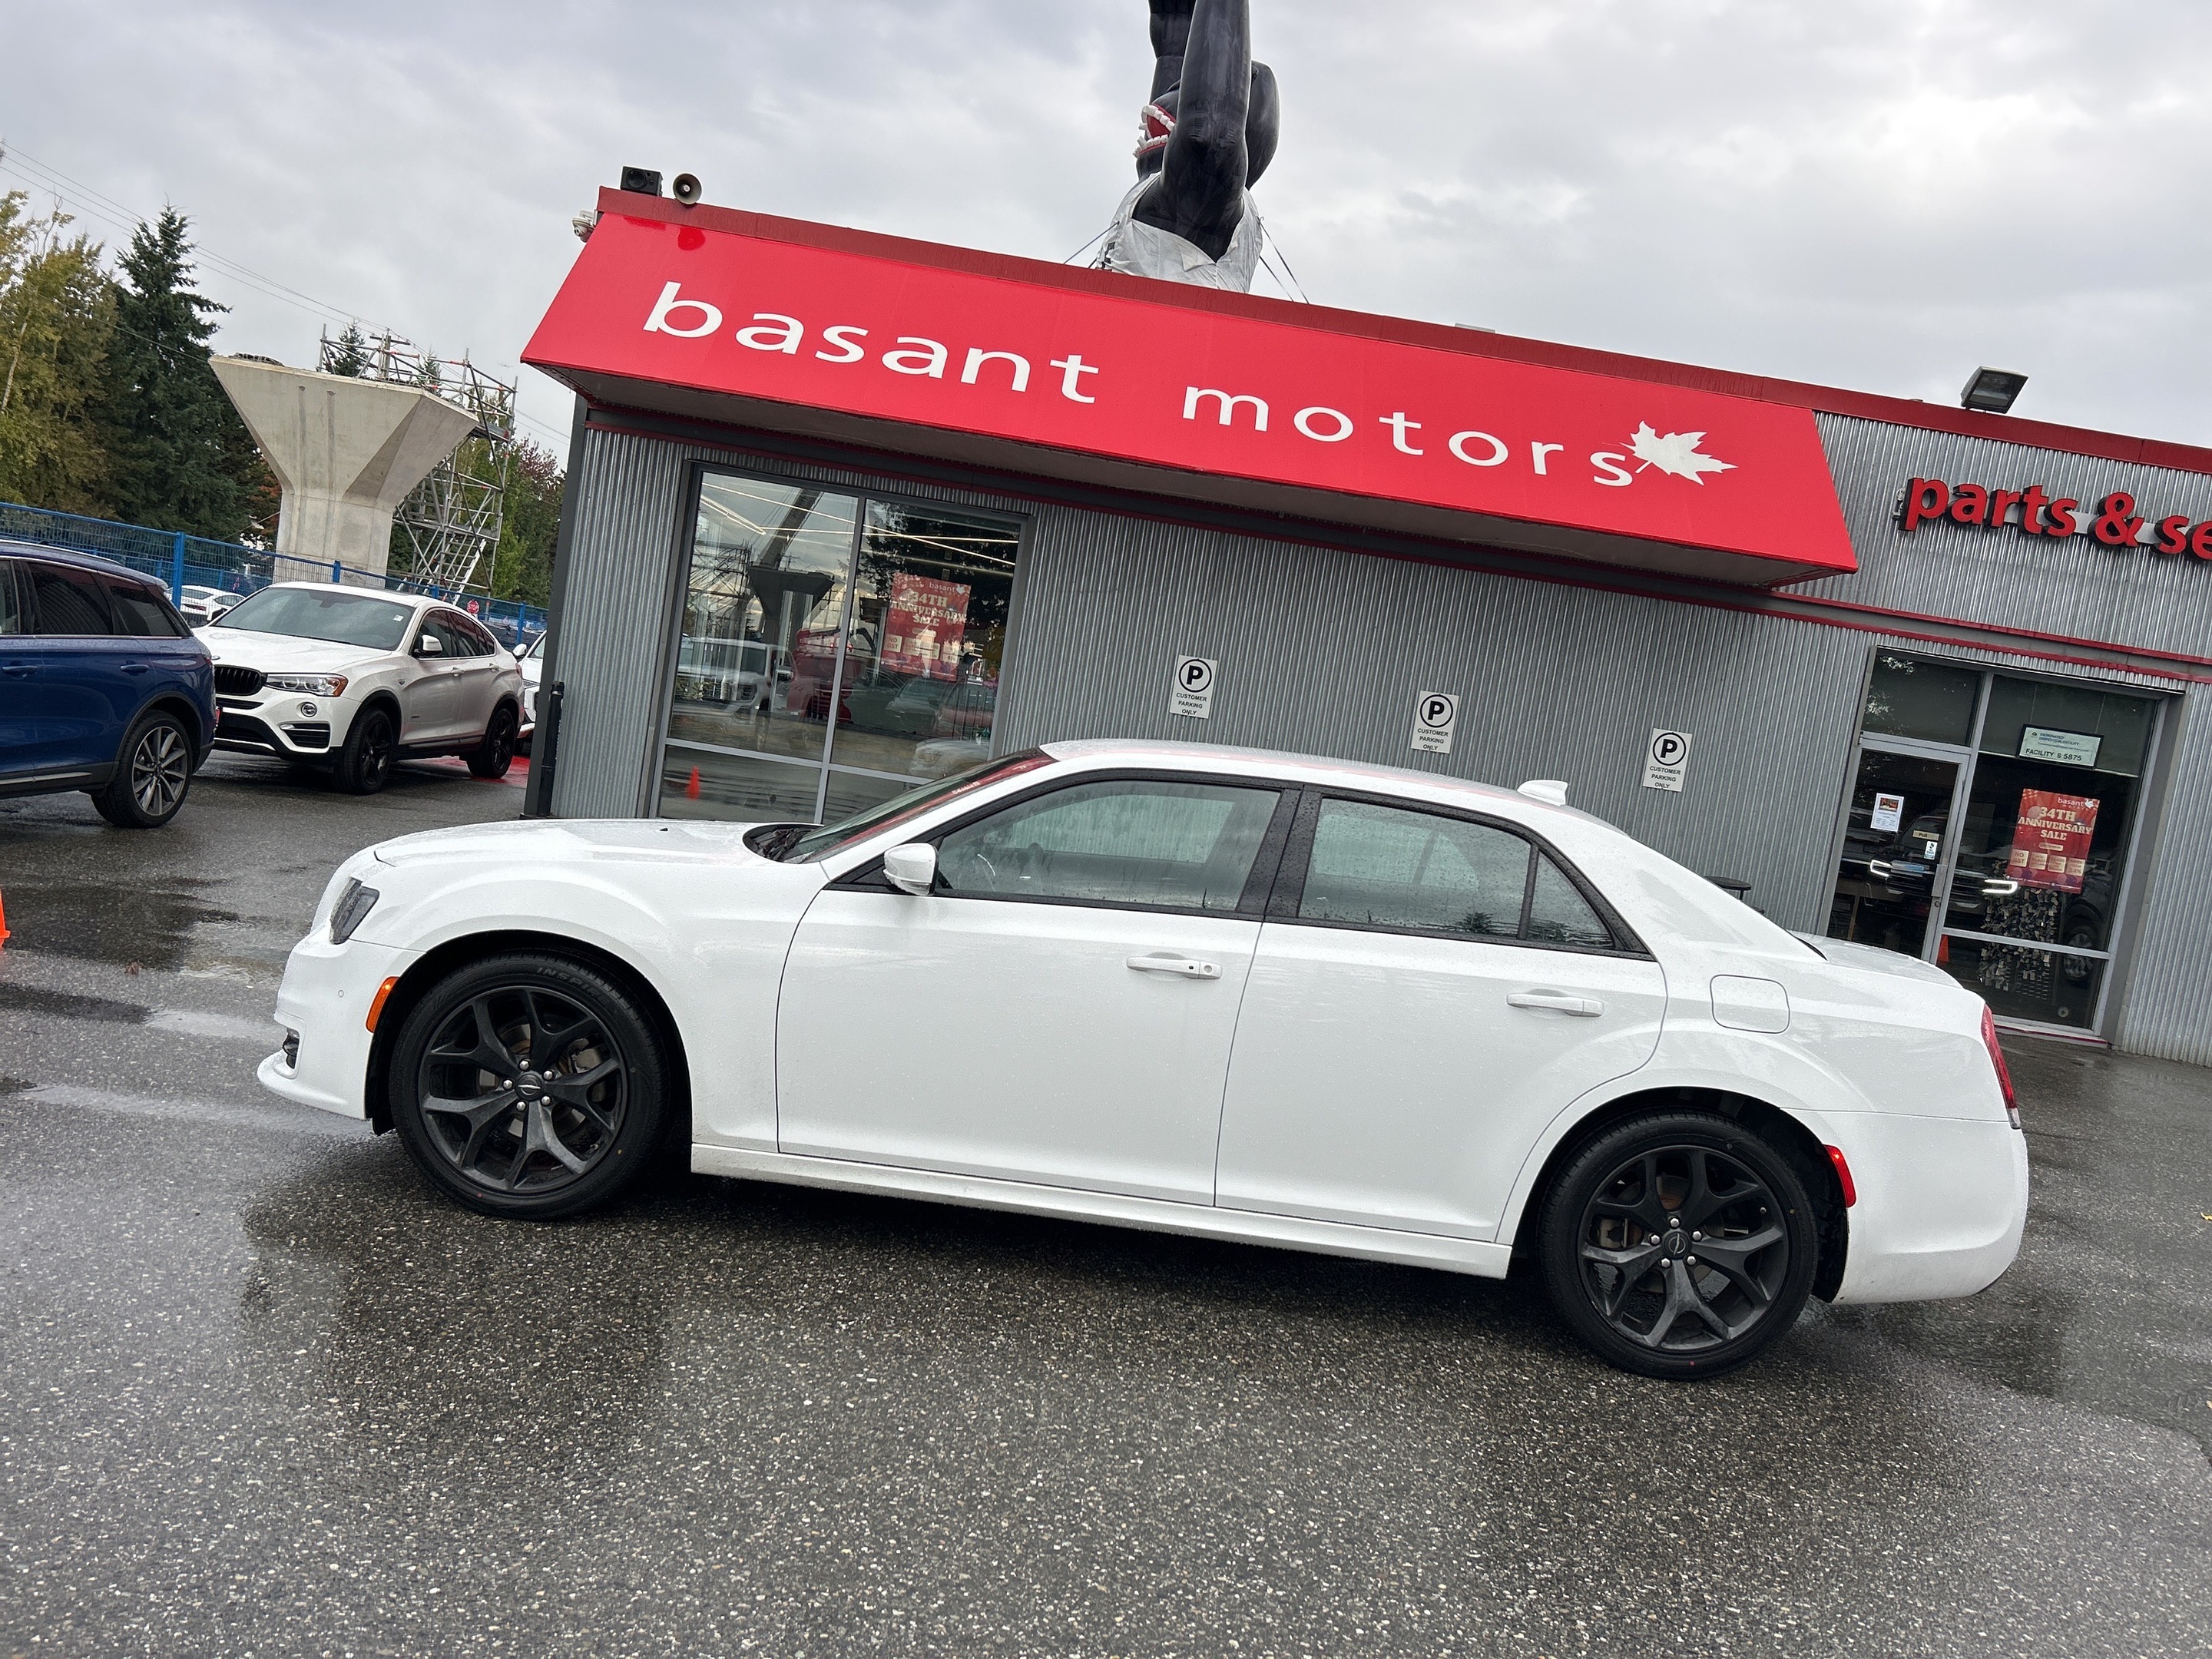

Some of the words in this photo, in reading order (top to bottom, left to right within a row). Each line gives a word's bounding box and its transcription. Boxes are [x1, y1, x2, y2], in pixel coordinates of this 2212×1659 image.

[643, 281, 1099, 404] basant
[1181, 386, 1633, 488] motors
[1900, 477, 2078, 537] parts
[2090, 492, 2145, 548] &
[929, 581, 955, 593] basant
[1186, 664, 1204, 685] P
[1176, 692, 1207, 702] CUSTOMER
[1177, 700, 1203, 709] PARKING
[1427, 700, 1445, 720] P
[1417, 728, 1449, 737] CUSTOMER
[1419, 736, 1444, 744] PARKING
[1660, 738, 1677, 759] P
[2025, 748, 2055, 757] FACILITY
[1649, 766, 1681, 775] CUSTOMER
[1651, 773, 1676, 782] PARKING
[2058, 796, 2085, 807] basant
[2038, 806, 2077, 822] 34TH
[2018, 816, 2092, 835] ANNIVERSARY
[2040, 830, 2068, 841] SALE
